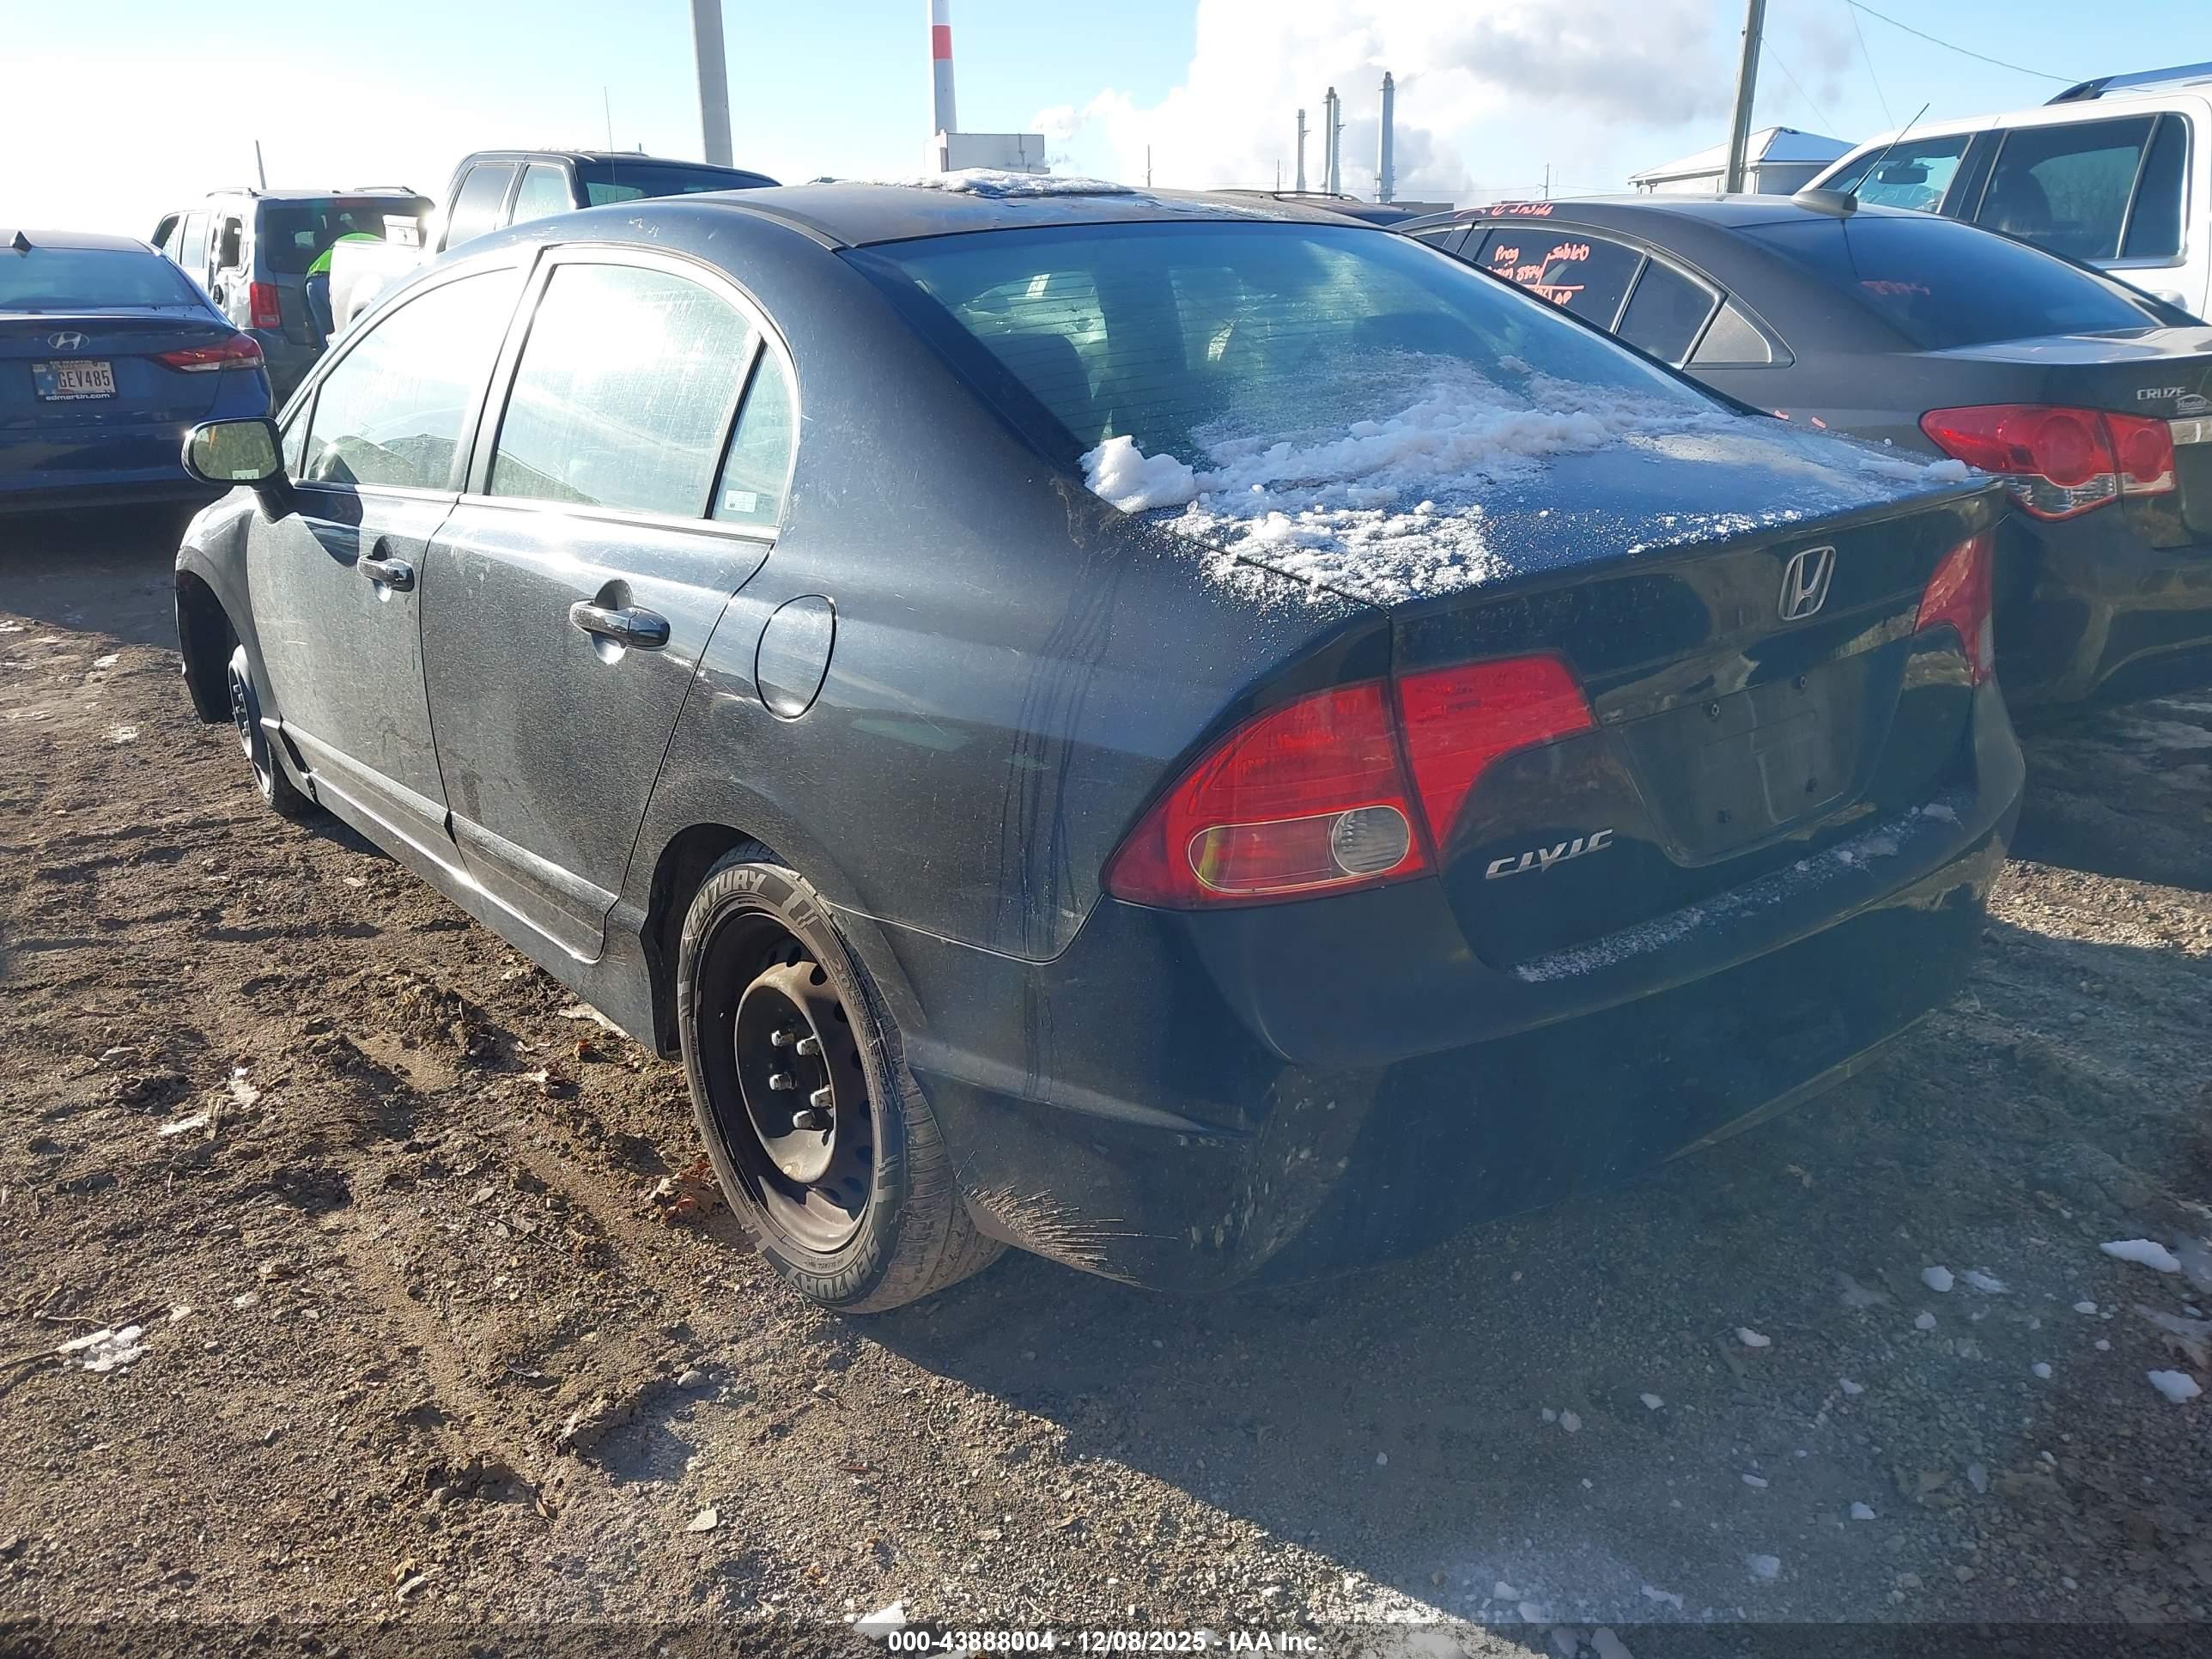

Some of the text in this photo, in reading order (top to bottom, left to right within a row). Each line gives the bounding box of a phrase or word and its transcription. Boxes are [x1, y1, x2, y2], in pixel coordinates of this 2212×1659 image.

[57, 369, 111, 388] GEV485
[46, 392, 111, 402] edmartin.com
[2136, 386, 2186, 400] CRUZE
[1486, 829, 1613, 879] CIVIC
[683, 869, 768, 939] CENTURY
